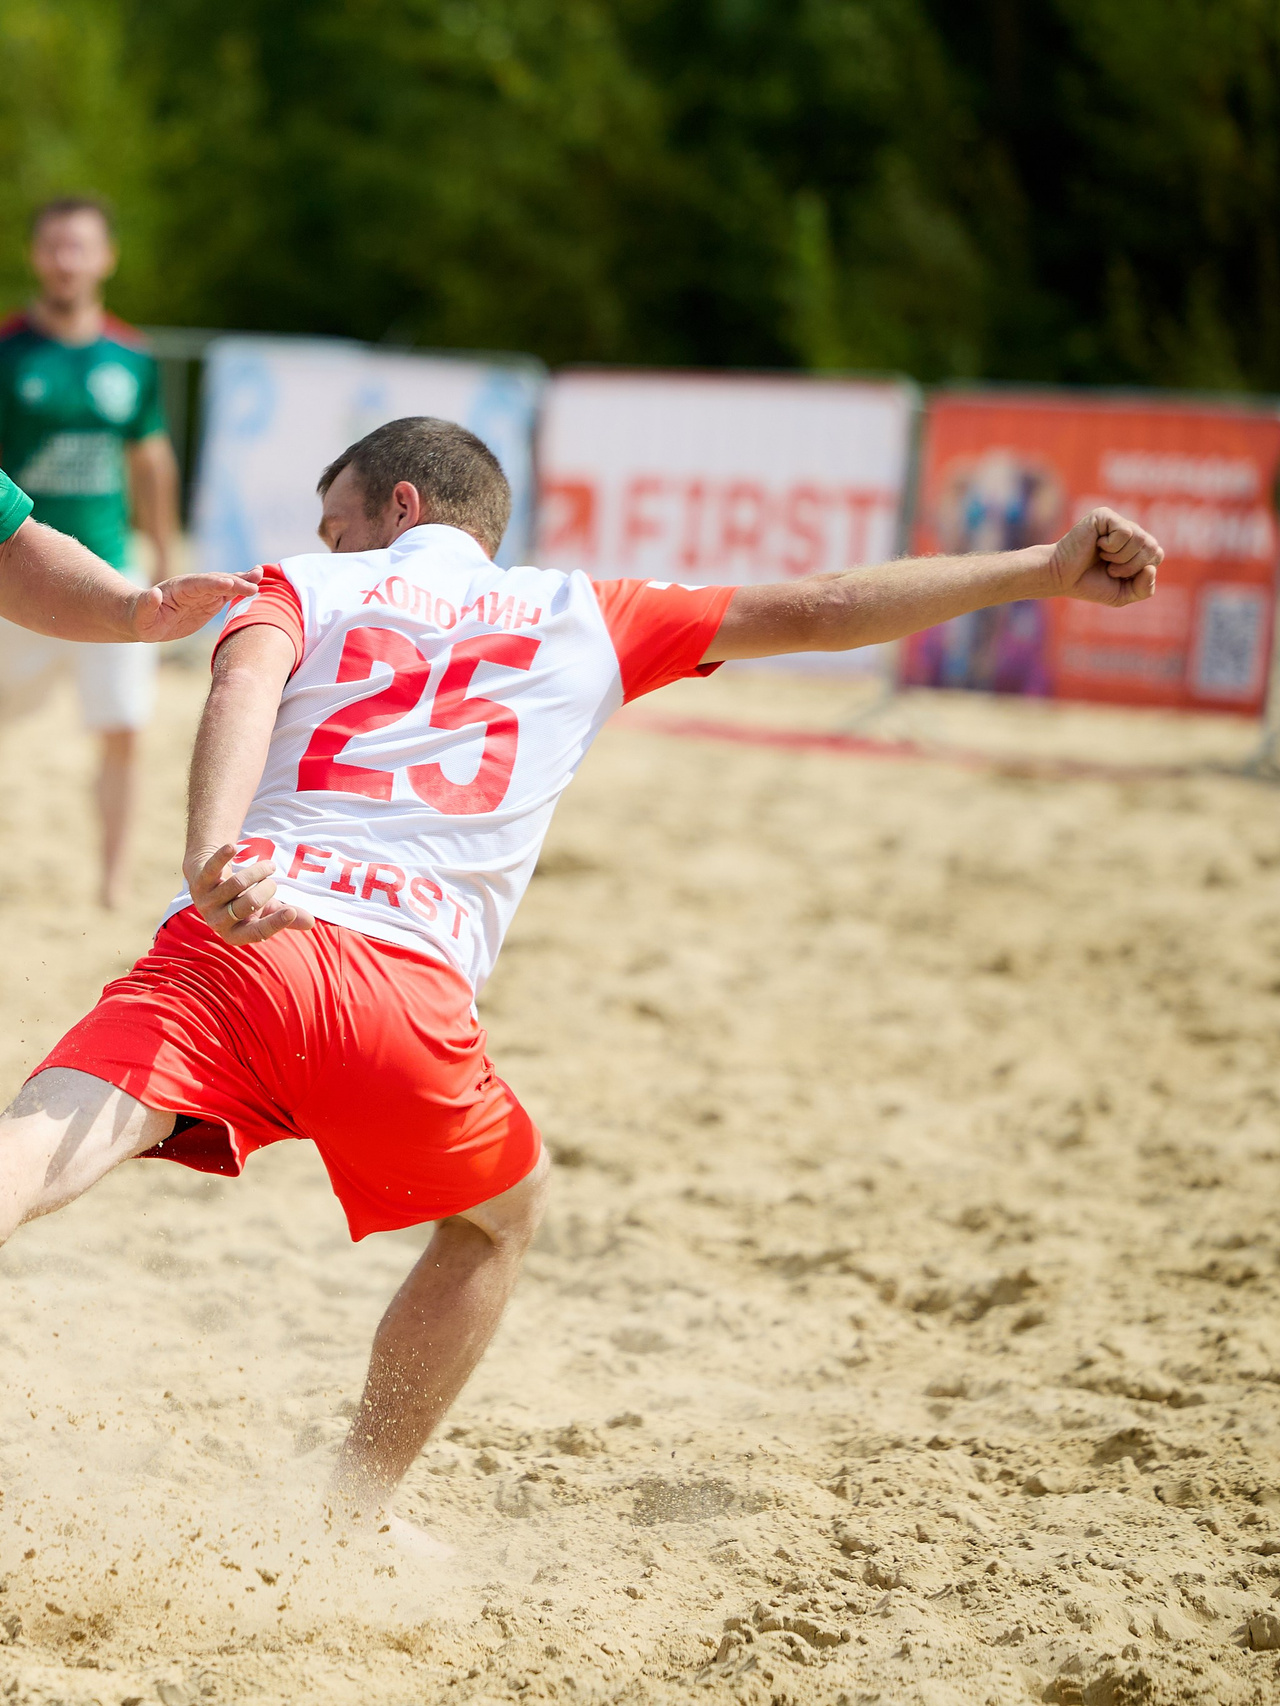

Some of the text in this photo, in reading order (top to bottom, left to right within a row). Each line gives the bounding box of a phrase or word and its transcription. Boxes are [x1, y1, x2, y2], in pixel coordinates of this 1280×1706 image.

[622, 474, 900, 580] FIRST
[296, 626, 542, 815] 25
[287, 843, 469, 940] FIRST
